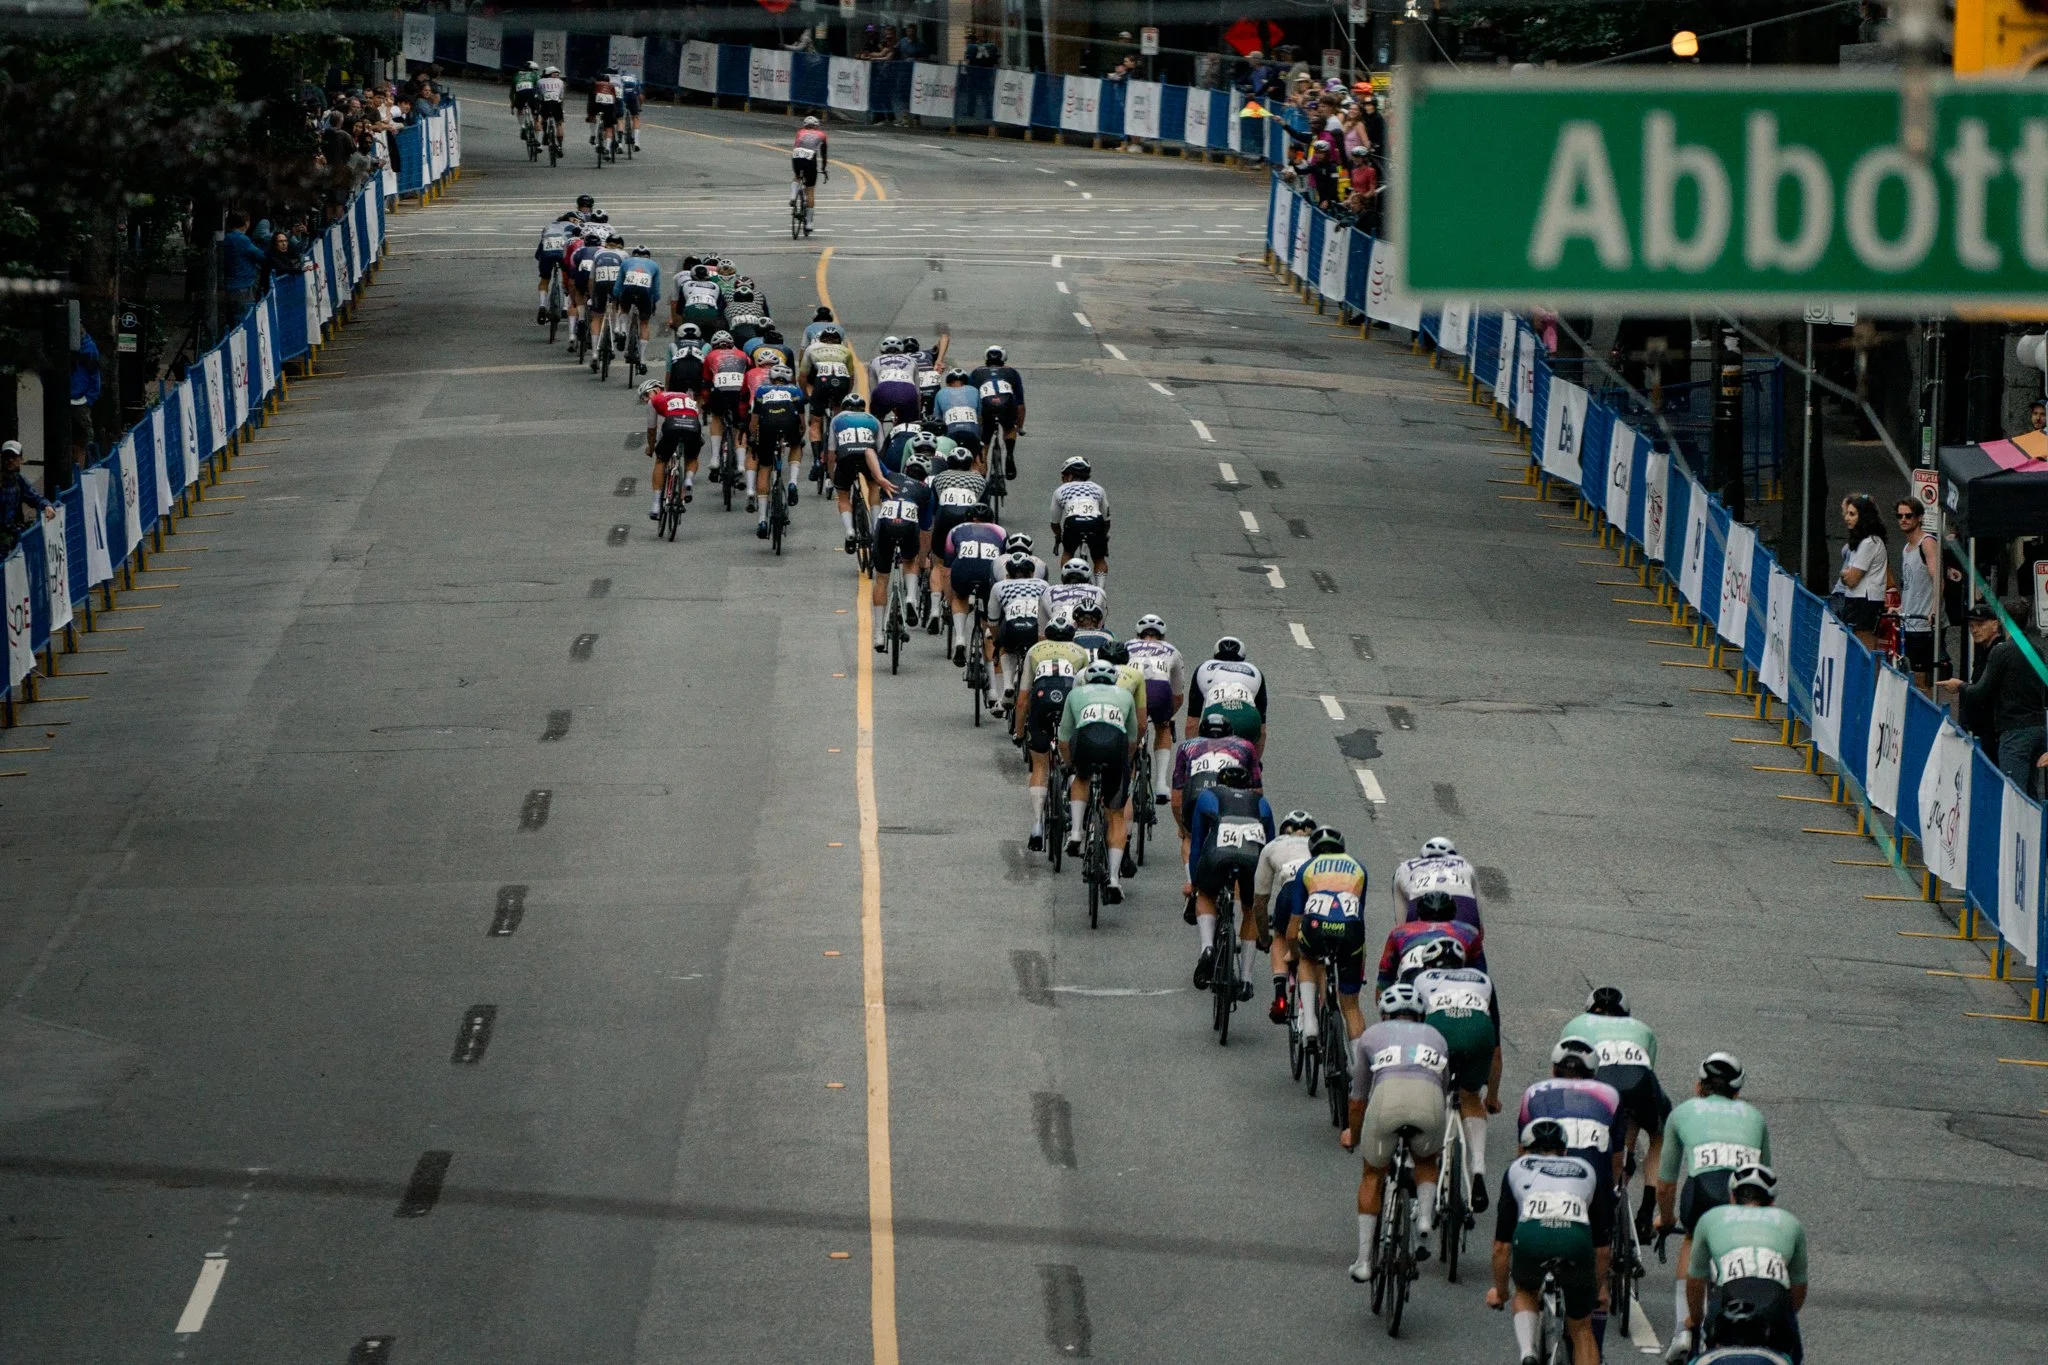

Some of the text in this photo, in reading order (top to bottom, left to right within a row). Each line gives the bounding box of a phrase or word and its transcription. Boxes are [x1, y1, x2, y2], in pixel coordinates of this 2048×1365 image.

[1524, 108, 2048, 273] Abbott
[718, 376, 727, 385] 13
[983, 387, 988, 395] 9
[949, 412, 975, 422] 15 15
[842, 431, 874, 442] 12 12
[944, 493, 972, 504] 16 16
[882, 506, 917, 519] 28 28
[1083, 504, 1093, 514] 39
[962, 546, 996, 558] 26 26
[1010, 605, 1021, 616] 45
[1214, 688, 1225, 700] 31
[1082, 708, 1122, 722] 64 64
[1196, 758, 1210, 771] 20
[1222, 830, 1238, 842] 54
[1313, 858, 1358, 876] FUTURE
[1308, 899, 1358, 913] 21 21
[1422, 1049, 1440, 1066] 33
[1625, 1048, 1642, 1061] 66
[1701, 1148, 1751, 1167] 51 51
[1529, 1200, 1582, 1217] 70 70
[1728, 1258, 1784, 1280] 41 41
